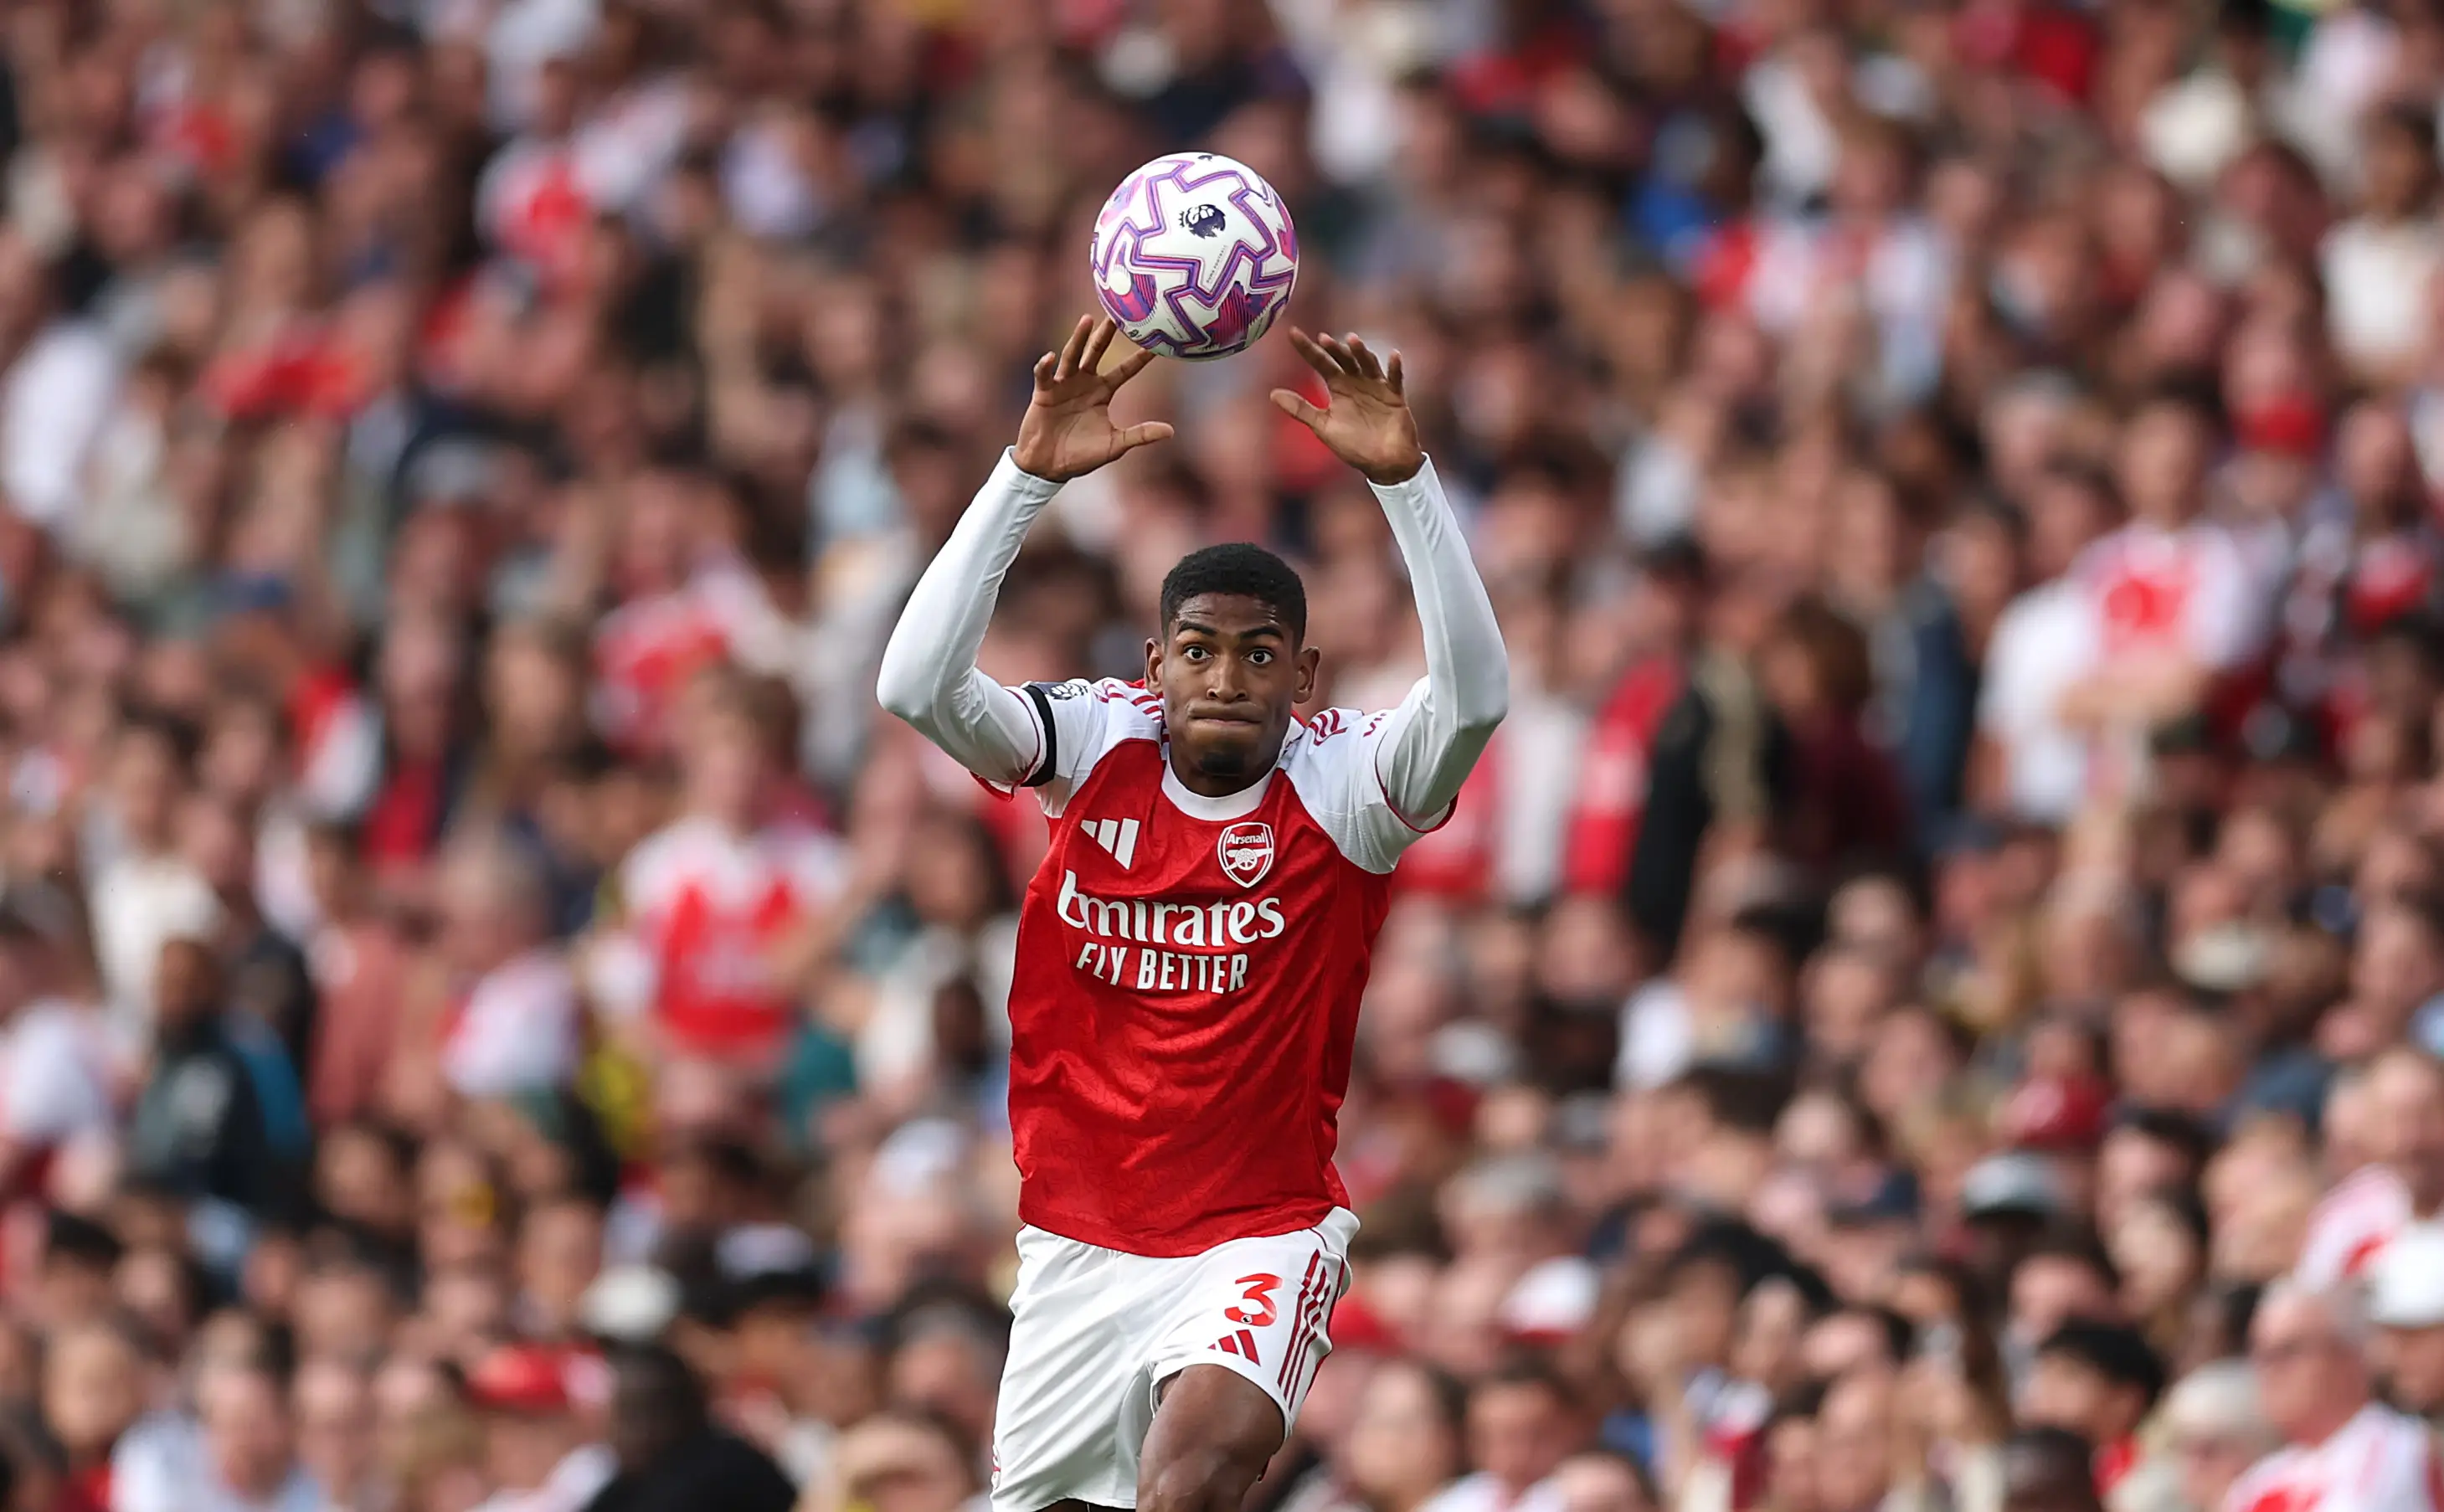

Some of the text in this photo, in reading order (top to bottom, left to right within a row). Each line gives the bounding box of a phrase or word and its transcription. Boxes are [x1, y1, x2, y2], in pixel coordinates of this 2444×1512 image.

[1227, 832, 1266, 844] Arsenal
[1076, 942, 1248, 994] FLY BETTER
[1224, 1273, 1284, 1327] 3
